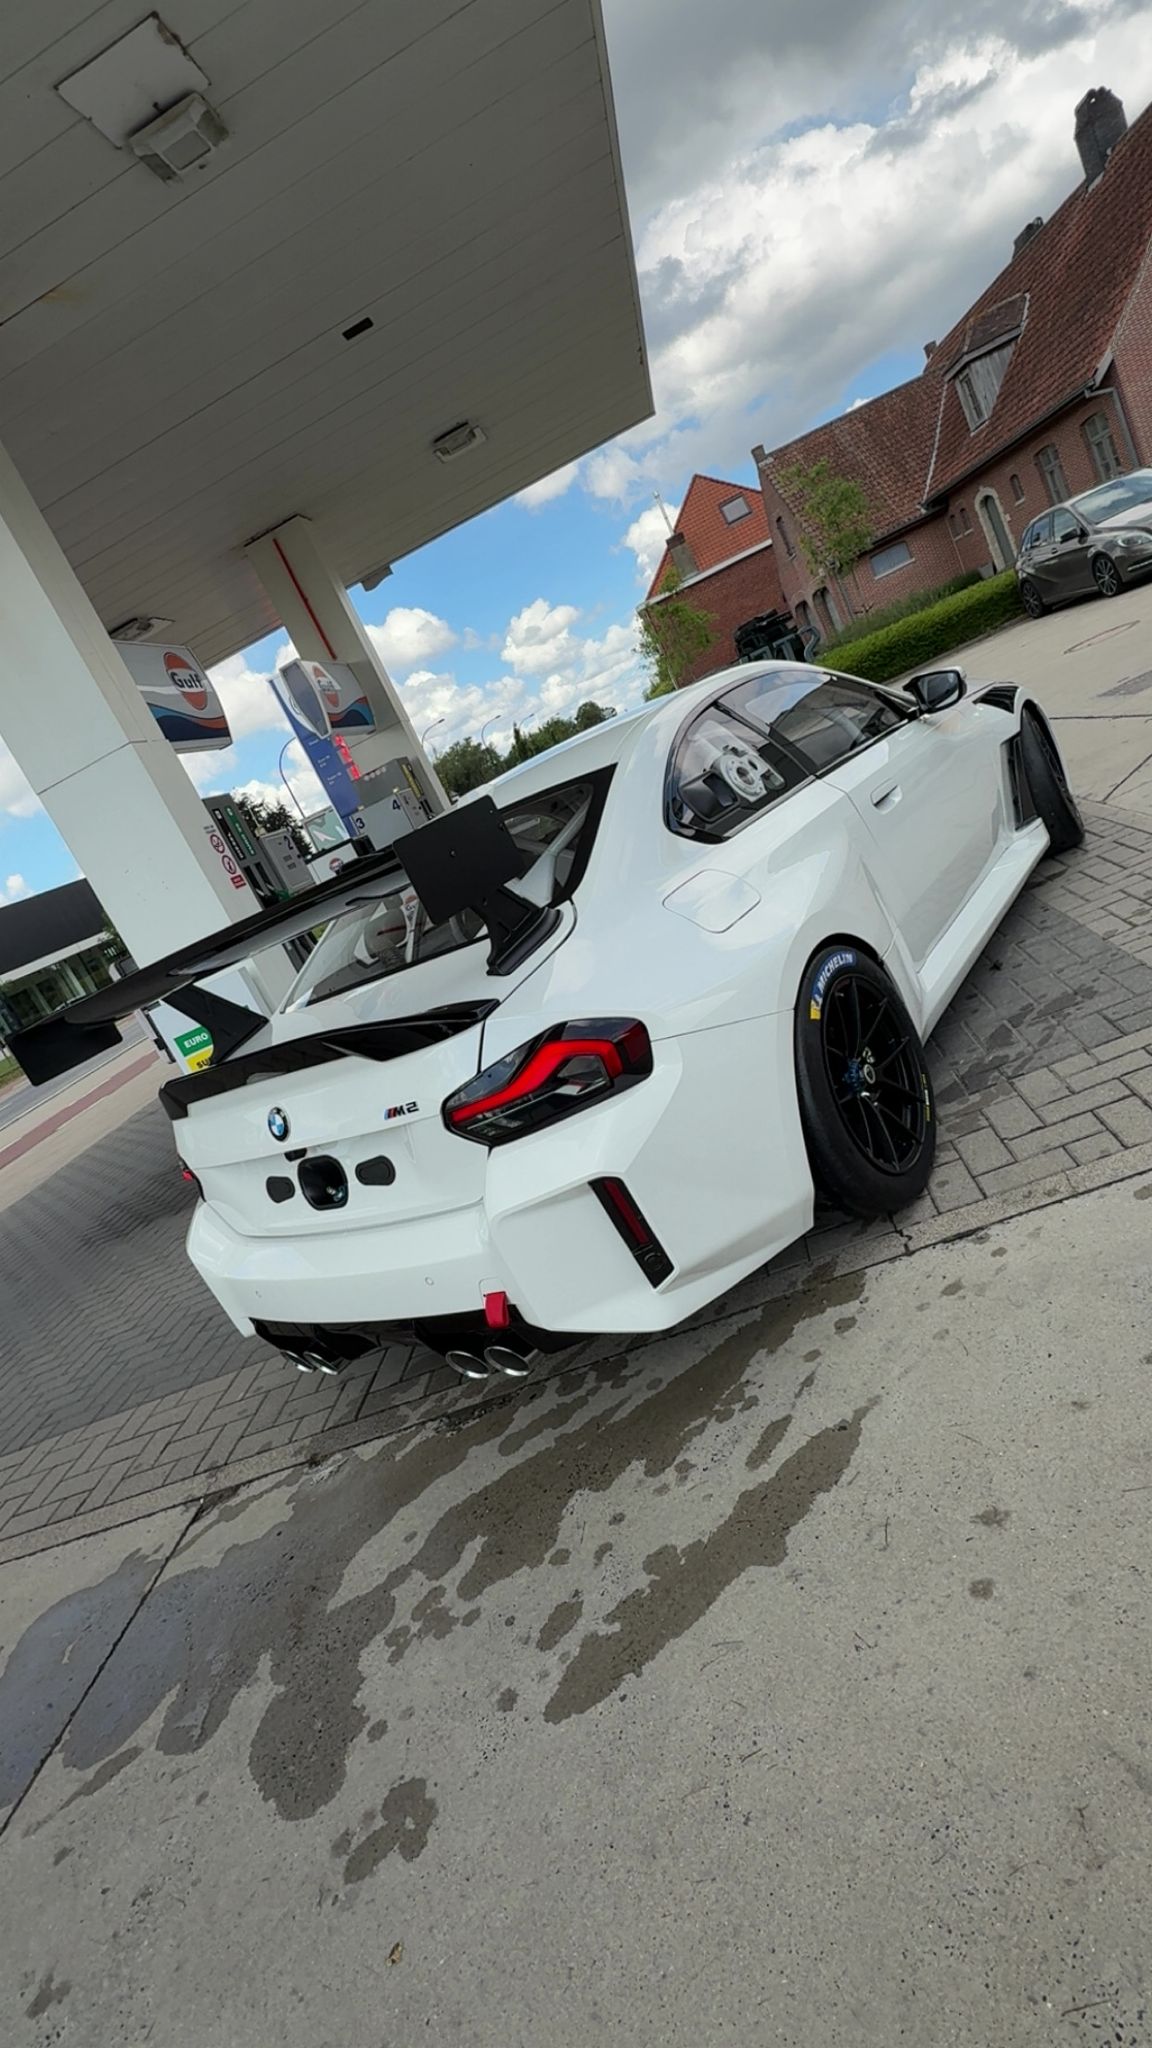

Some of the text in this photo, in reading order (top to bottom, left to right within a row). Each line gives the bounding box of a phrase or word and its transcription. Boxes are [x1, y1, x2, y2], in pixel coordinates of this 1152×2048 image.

[170, 671, 204, 688] Gulf
[392, 799, 401, 810] 4
[355, 817, 365, 829] 3
[283, 835, 294, 849] 2
[816, 951, 854, 994] MICHELIN
[183, 1032, 209, 1049] EURO
[387, 1101, 419, 1119] M2
